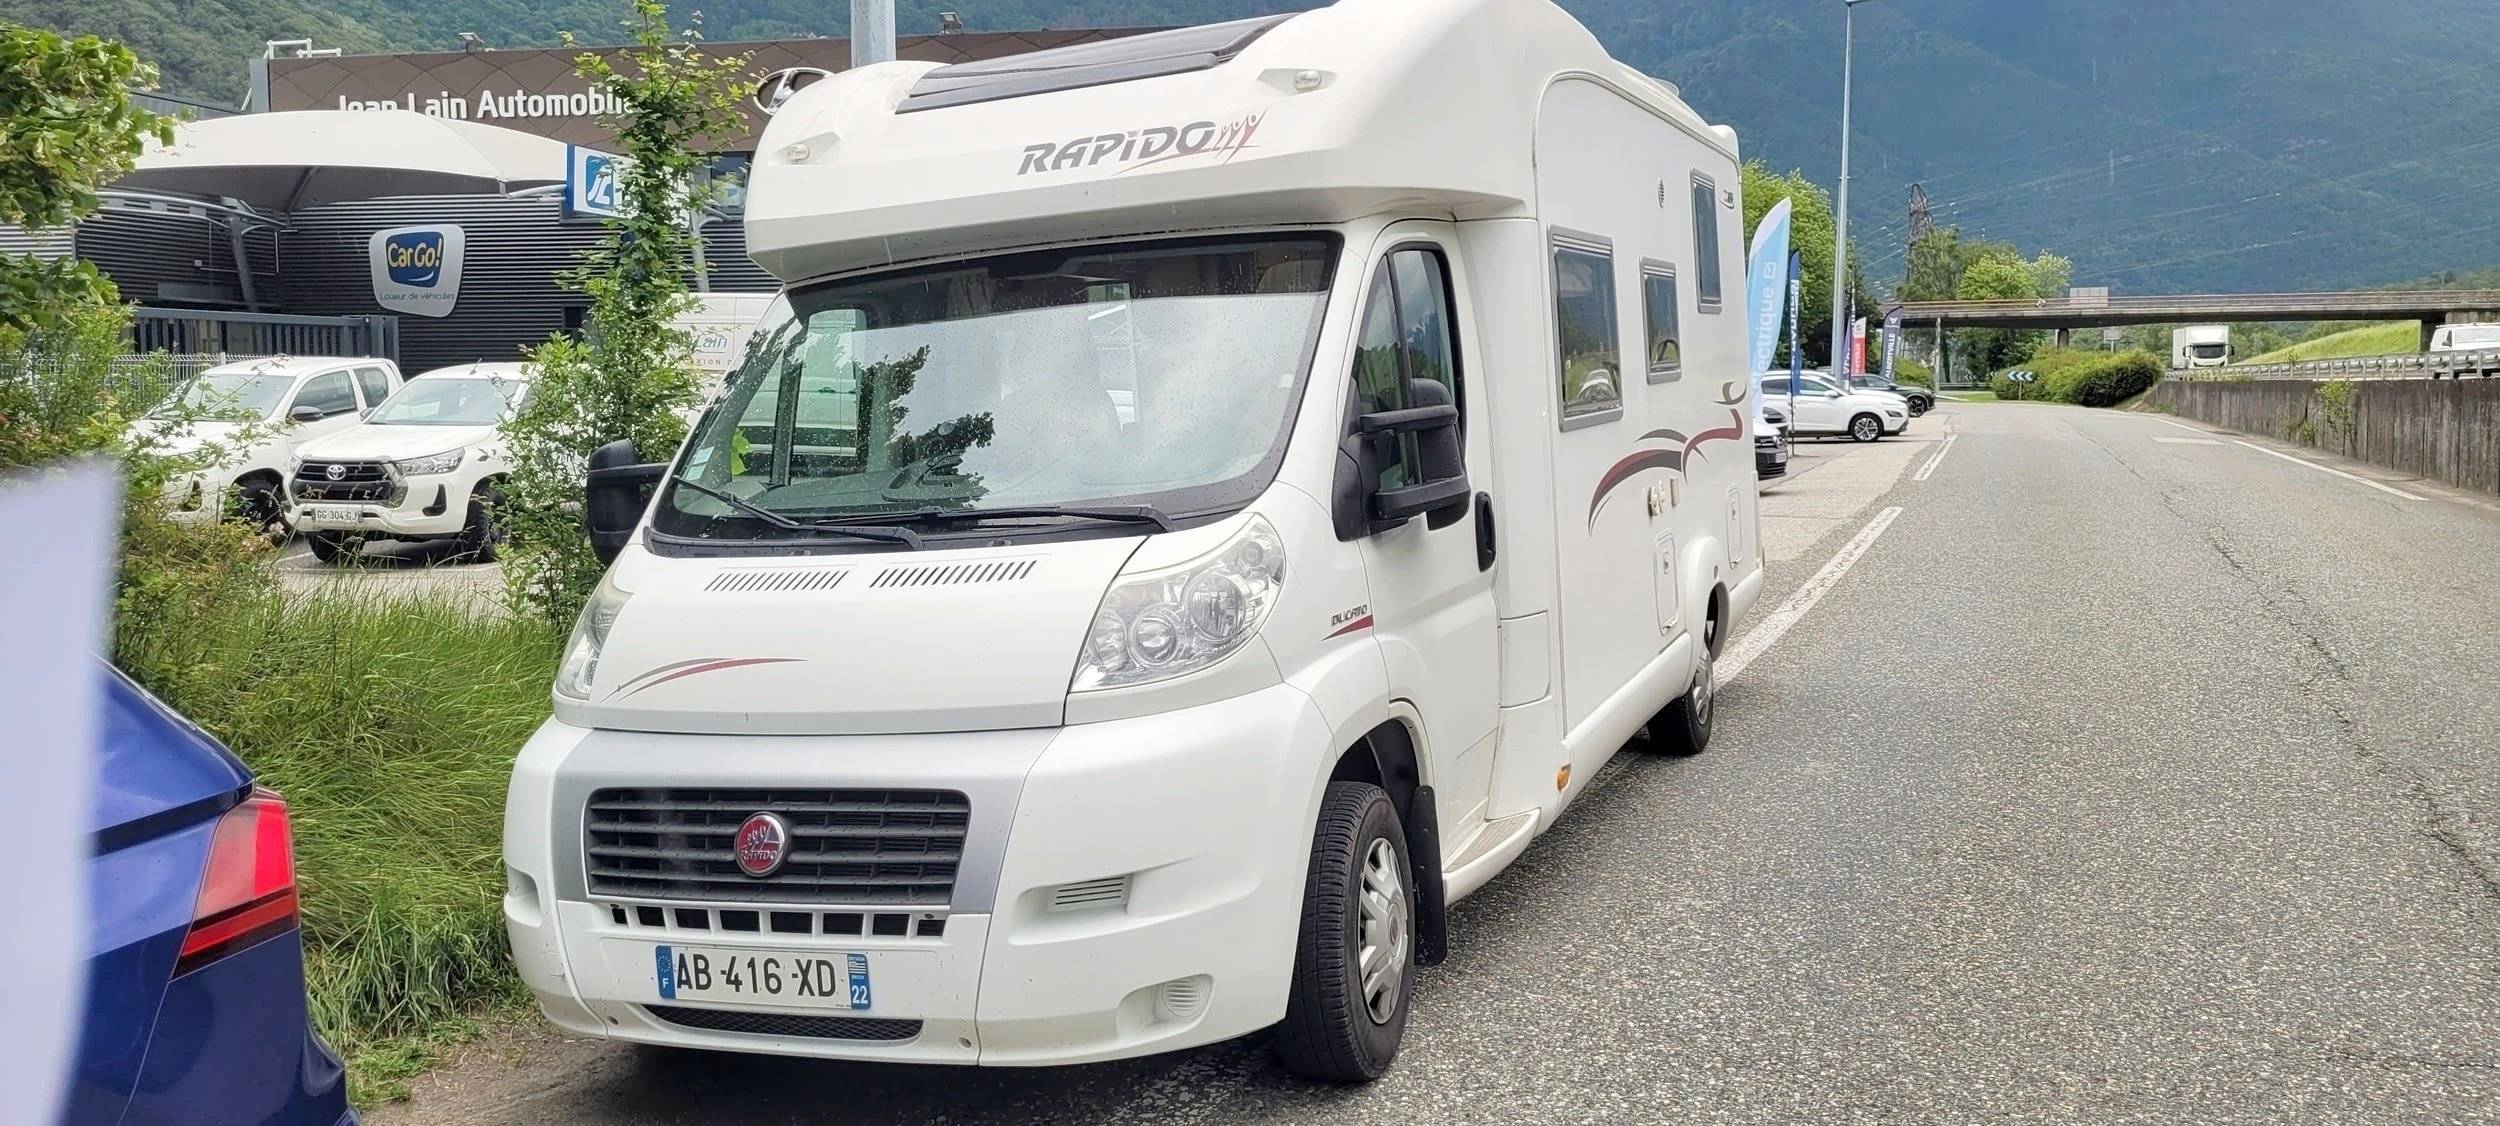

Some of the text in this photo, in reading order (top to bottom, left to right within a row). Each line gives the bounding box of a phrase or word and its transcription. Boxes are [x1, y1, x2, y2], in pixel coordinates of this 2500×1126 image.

[477, 86, 640, 118] Automobile
[1331, 604, 1368, 627] DUCATO
[662, 977, 670, 989] F
[851, 985, 869, 1004] 22
